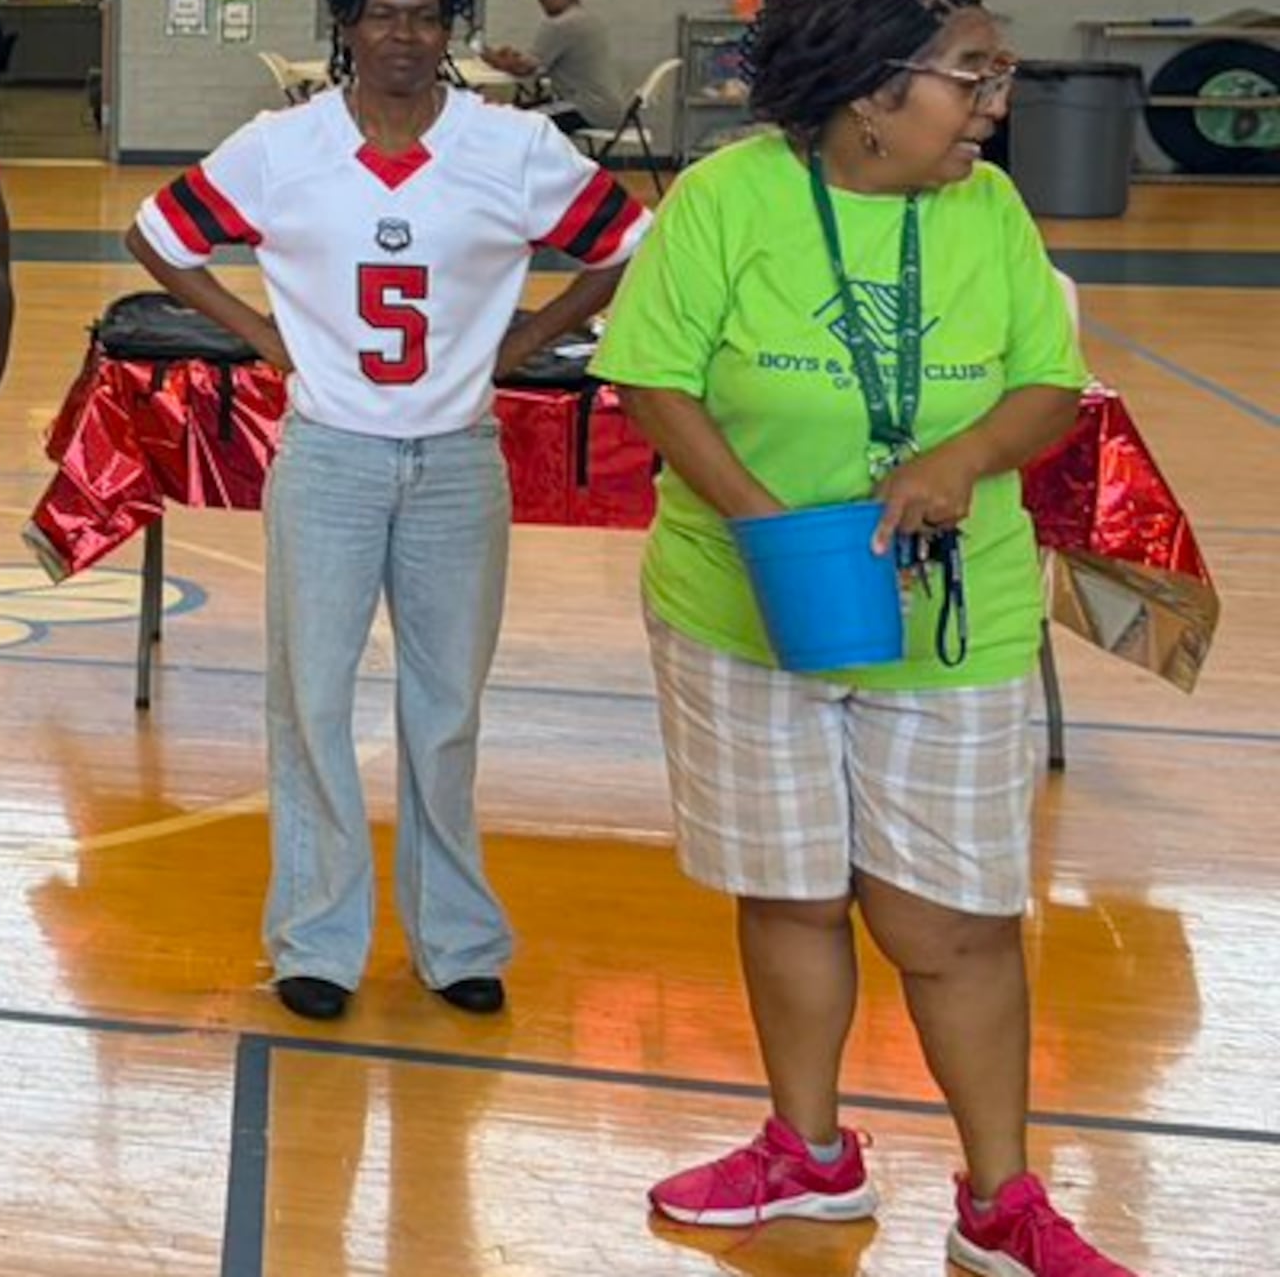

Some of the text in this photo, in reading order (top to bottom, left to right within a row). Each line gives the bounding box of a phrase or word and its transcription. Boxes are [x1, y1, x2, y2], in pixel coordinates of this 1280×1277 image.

[358, 263, 430, 386] 5
[757, 351, 819, 371] BOYS
[825, 358, 843, 374] &
